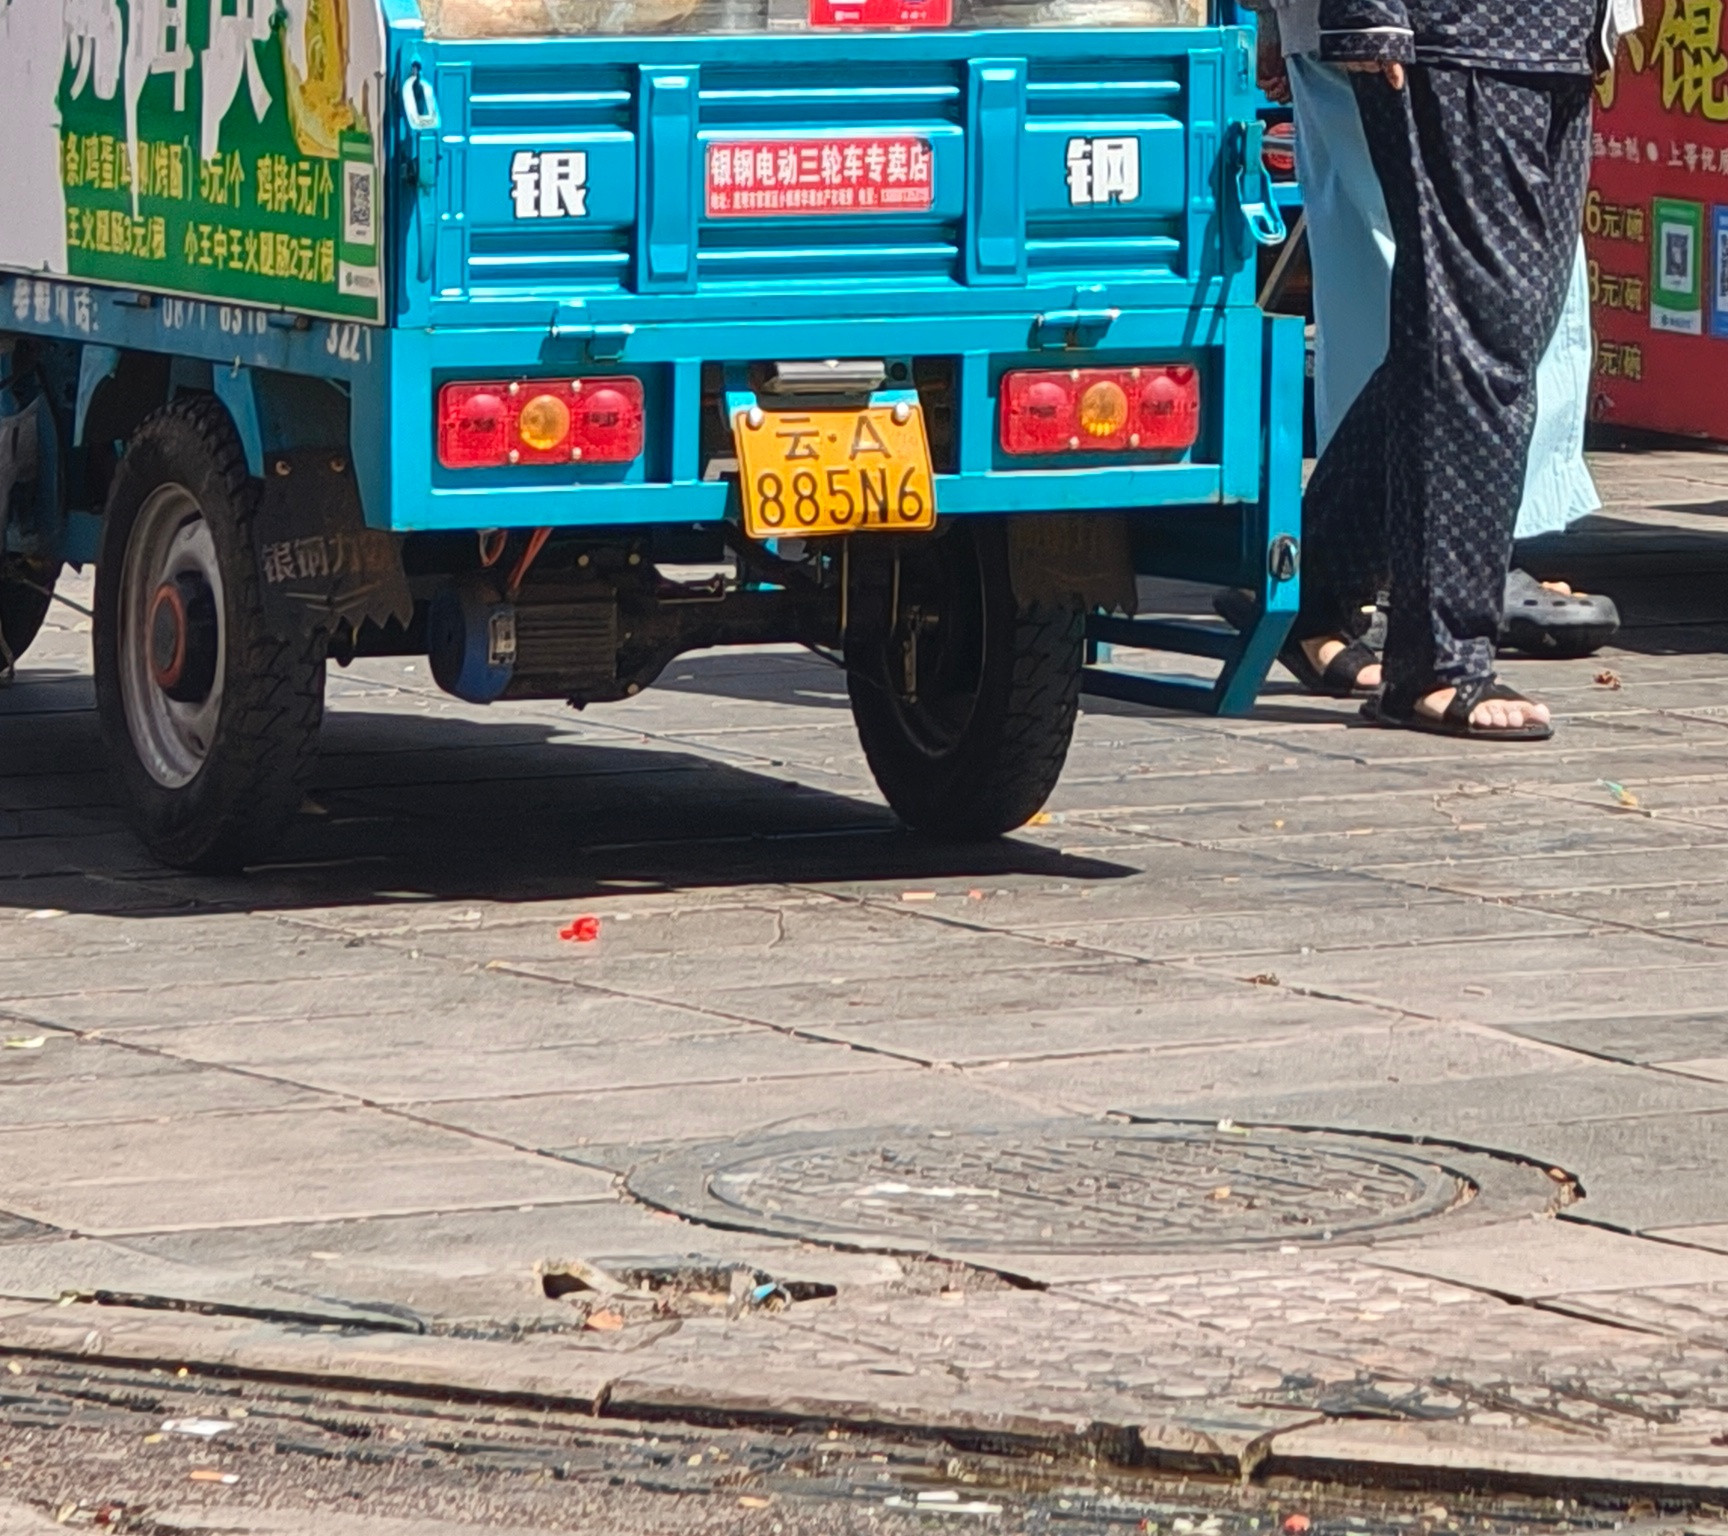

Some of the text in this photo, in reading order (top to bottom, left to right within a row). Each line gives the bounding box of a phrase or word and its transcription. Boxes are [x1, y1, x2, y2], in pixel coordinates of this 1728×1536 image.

[511, 136, 1141, 219] 银 钢
[711, 143, 930, 188] 银钢电动三轮车专卖店
[1586, 190, 1644, 242] 6元/碗
[757, 467, 924, 527] 885N6
